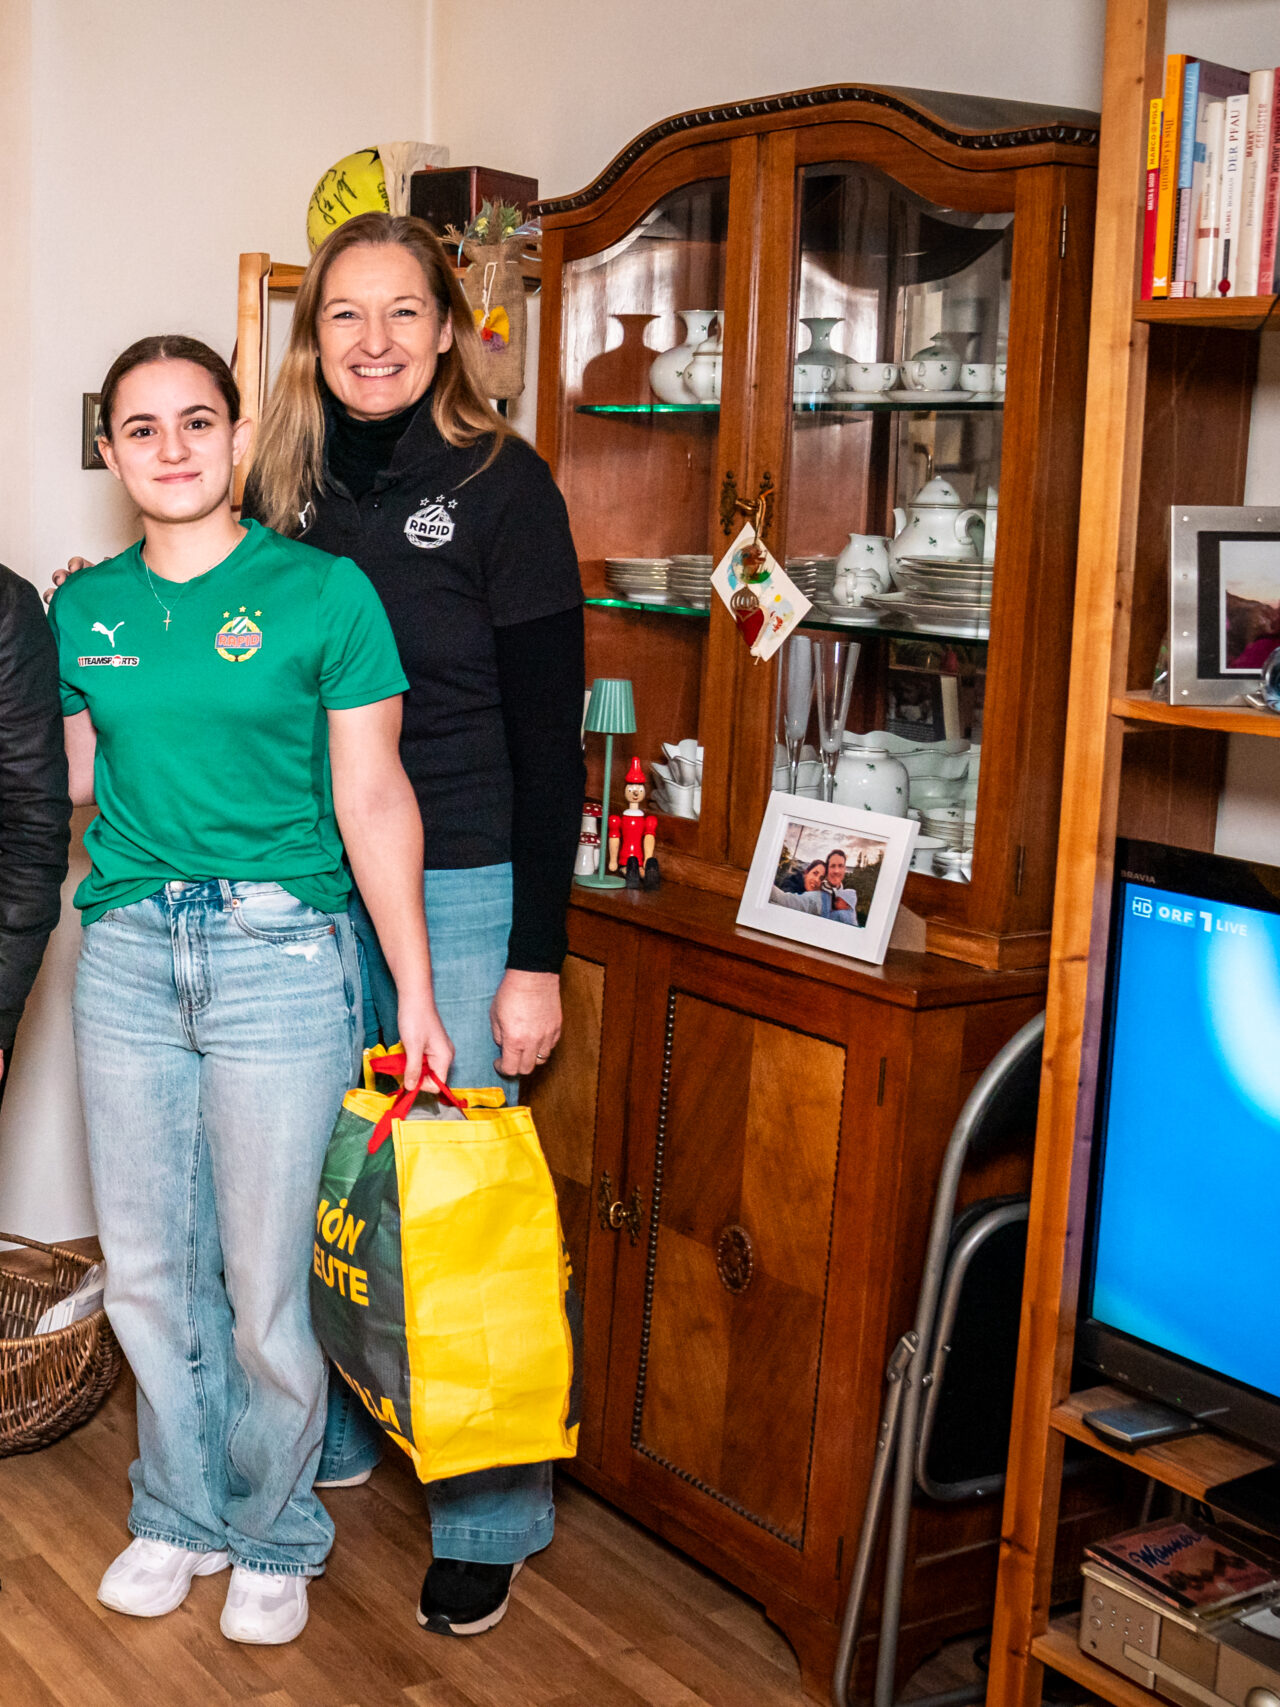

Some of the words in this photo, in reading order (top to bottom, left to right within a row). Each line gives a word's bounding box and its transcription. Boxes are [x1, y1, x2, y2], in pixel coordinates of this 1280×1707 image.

[1229, 110, 1240, 142] PFAU
[1149, 134, 1157, 165] MARCO
[1246, 130, 1255, 158] MARKT
[1227, 146, 1238, 172] DER
[409, 519, 450, 536] RAPID
[218, 634, 260, 647] RAPID
[1132, 899, 1152, 915] HD
[1158, 906, 1194, 923] ORF
[1199, 911, 1212, 933] 1
[1216, 919, 1248, 937] LIVE
[313, 1241, 369, 1306] EUTE
